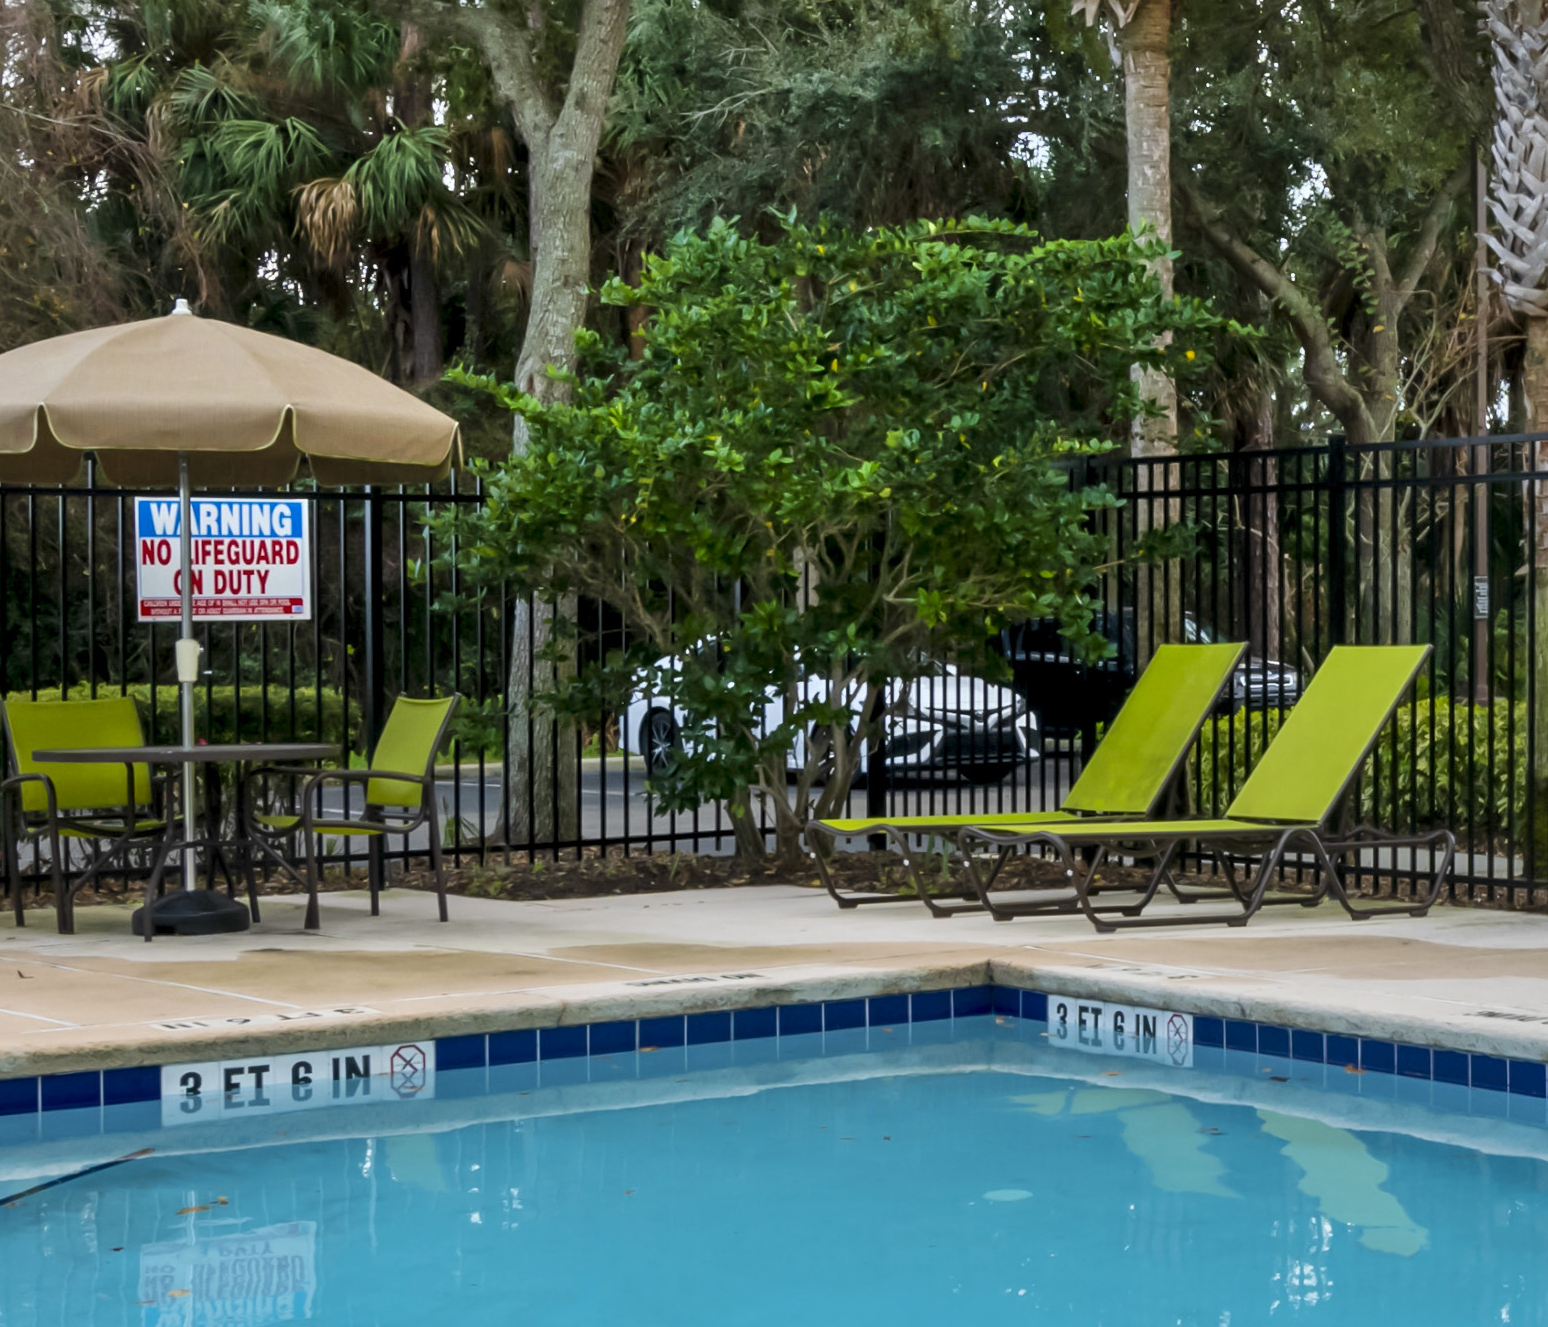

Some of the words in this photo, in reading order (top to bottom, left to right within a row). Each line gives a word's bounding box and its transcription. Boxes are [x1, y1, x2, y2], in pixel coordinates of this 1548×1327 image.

[142, 539, 171, 565] NO
[191, 539, 300, 565] IFEGUARD
[214, 569, 270, 595] DUTY
